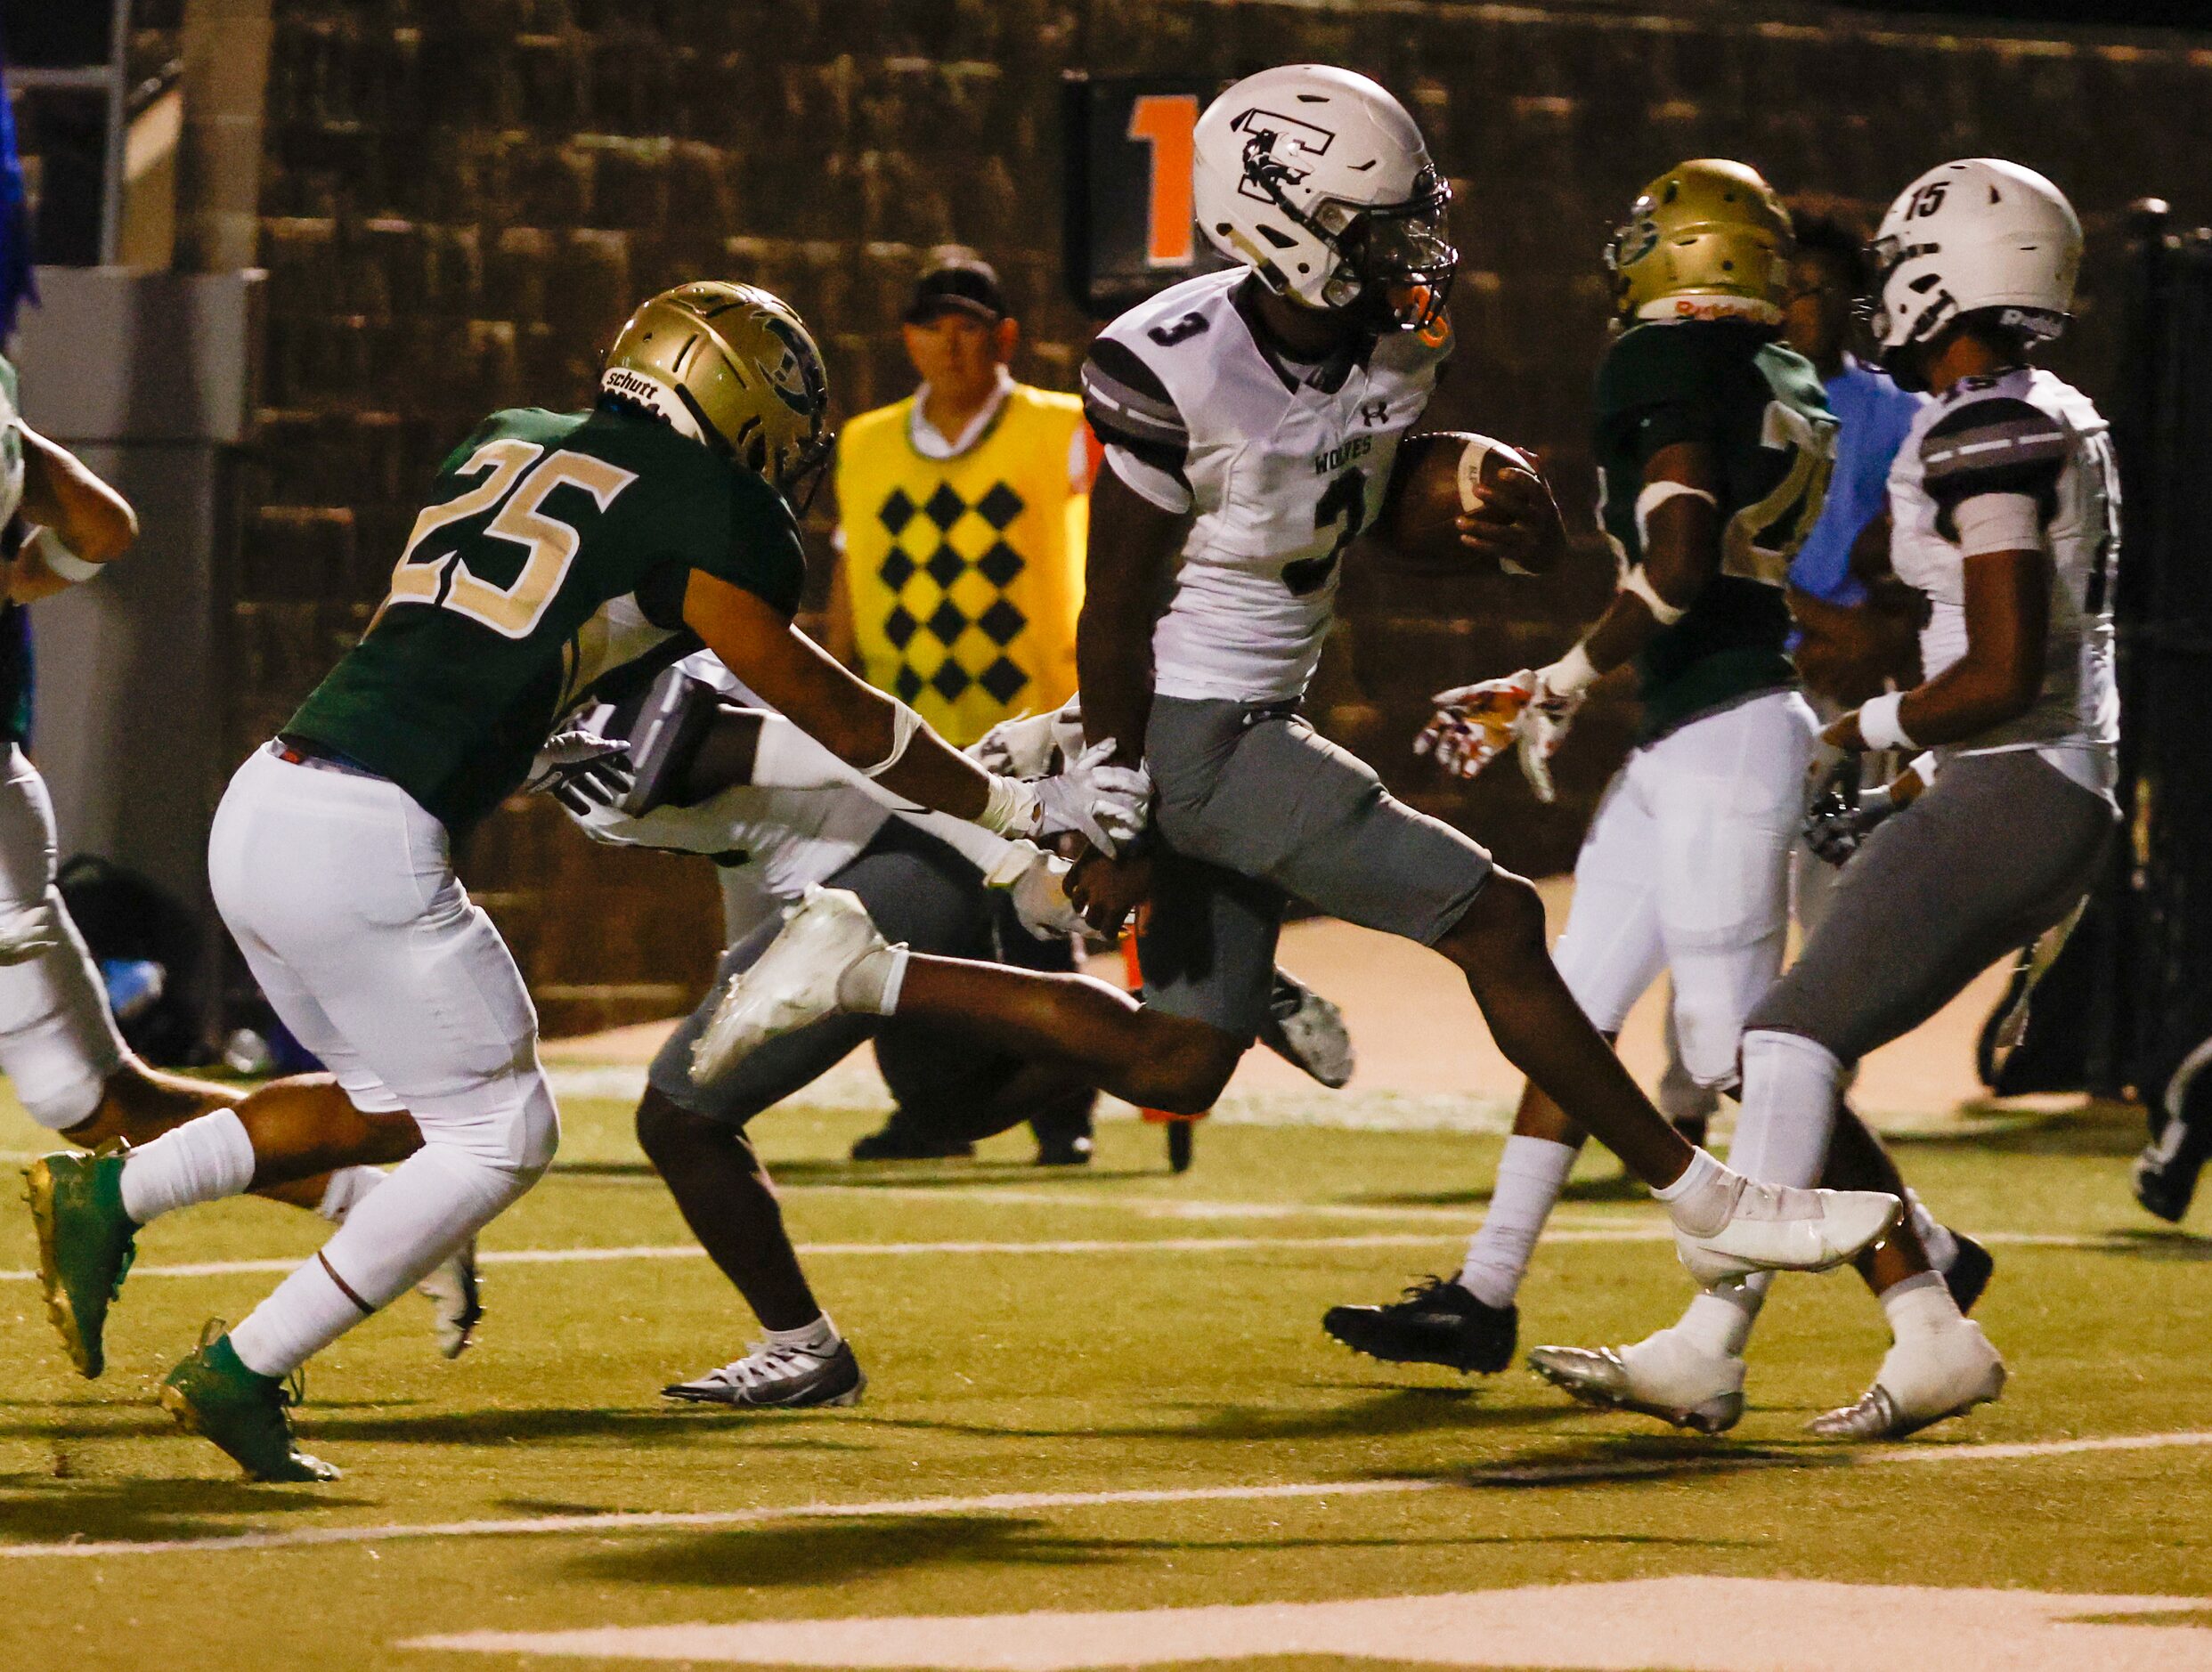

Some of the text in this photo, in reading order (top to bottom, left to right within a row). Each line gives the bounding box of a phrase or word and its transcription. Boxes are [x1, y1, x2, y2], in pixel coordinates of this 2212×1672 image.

[1126, 94, 1199, 267] 1
[1906, 181, 1951, 221] 15
[1147, 312, 1210, 347] 3
[606, 371, 658, 400] schutt
[1314, 434, 1373, 475] WOLVES
[388, 438, 640, 640] 25
[1281, 466, 1368, 597] 3
